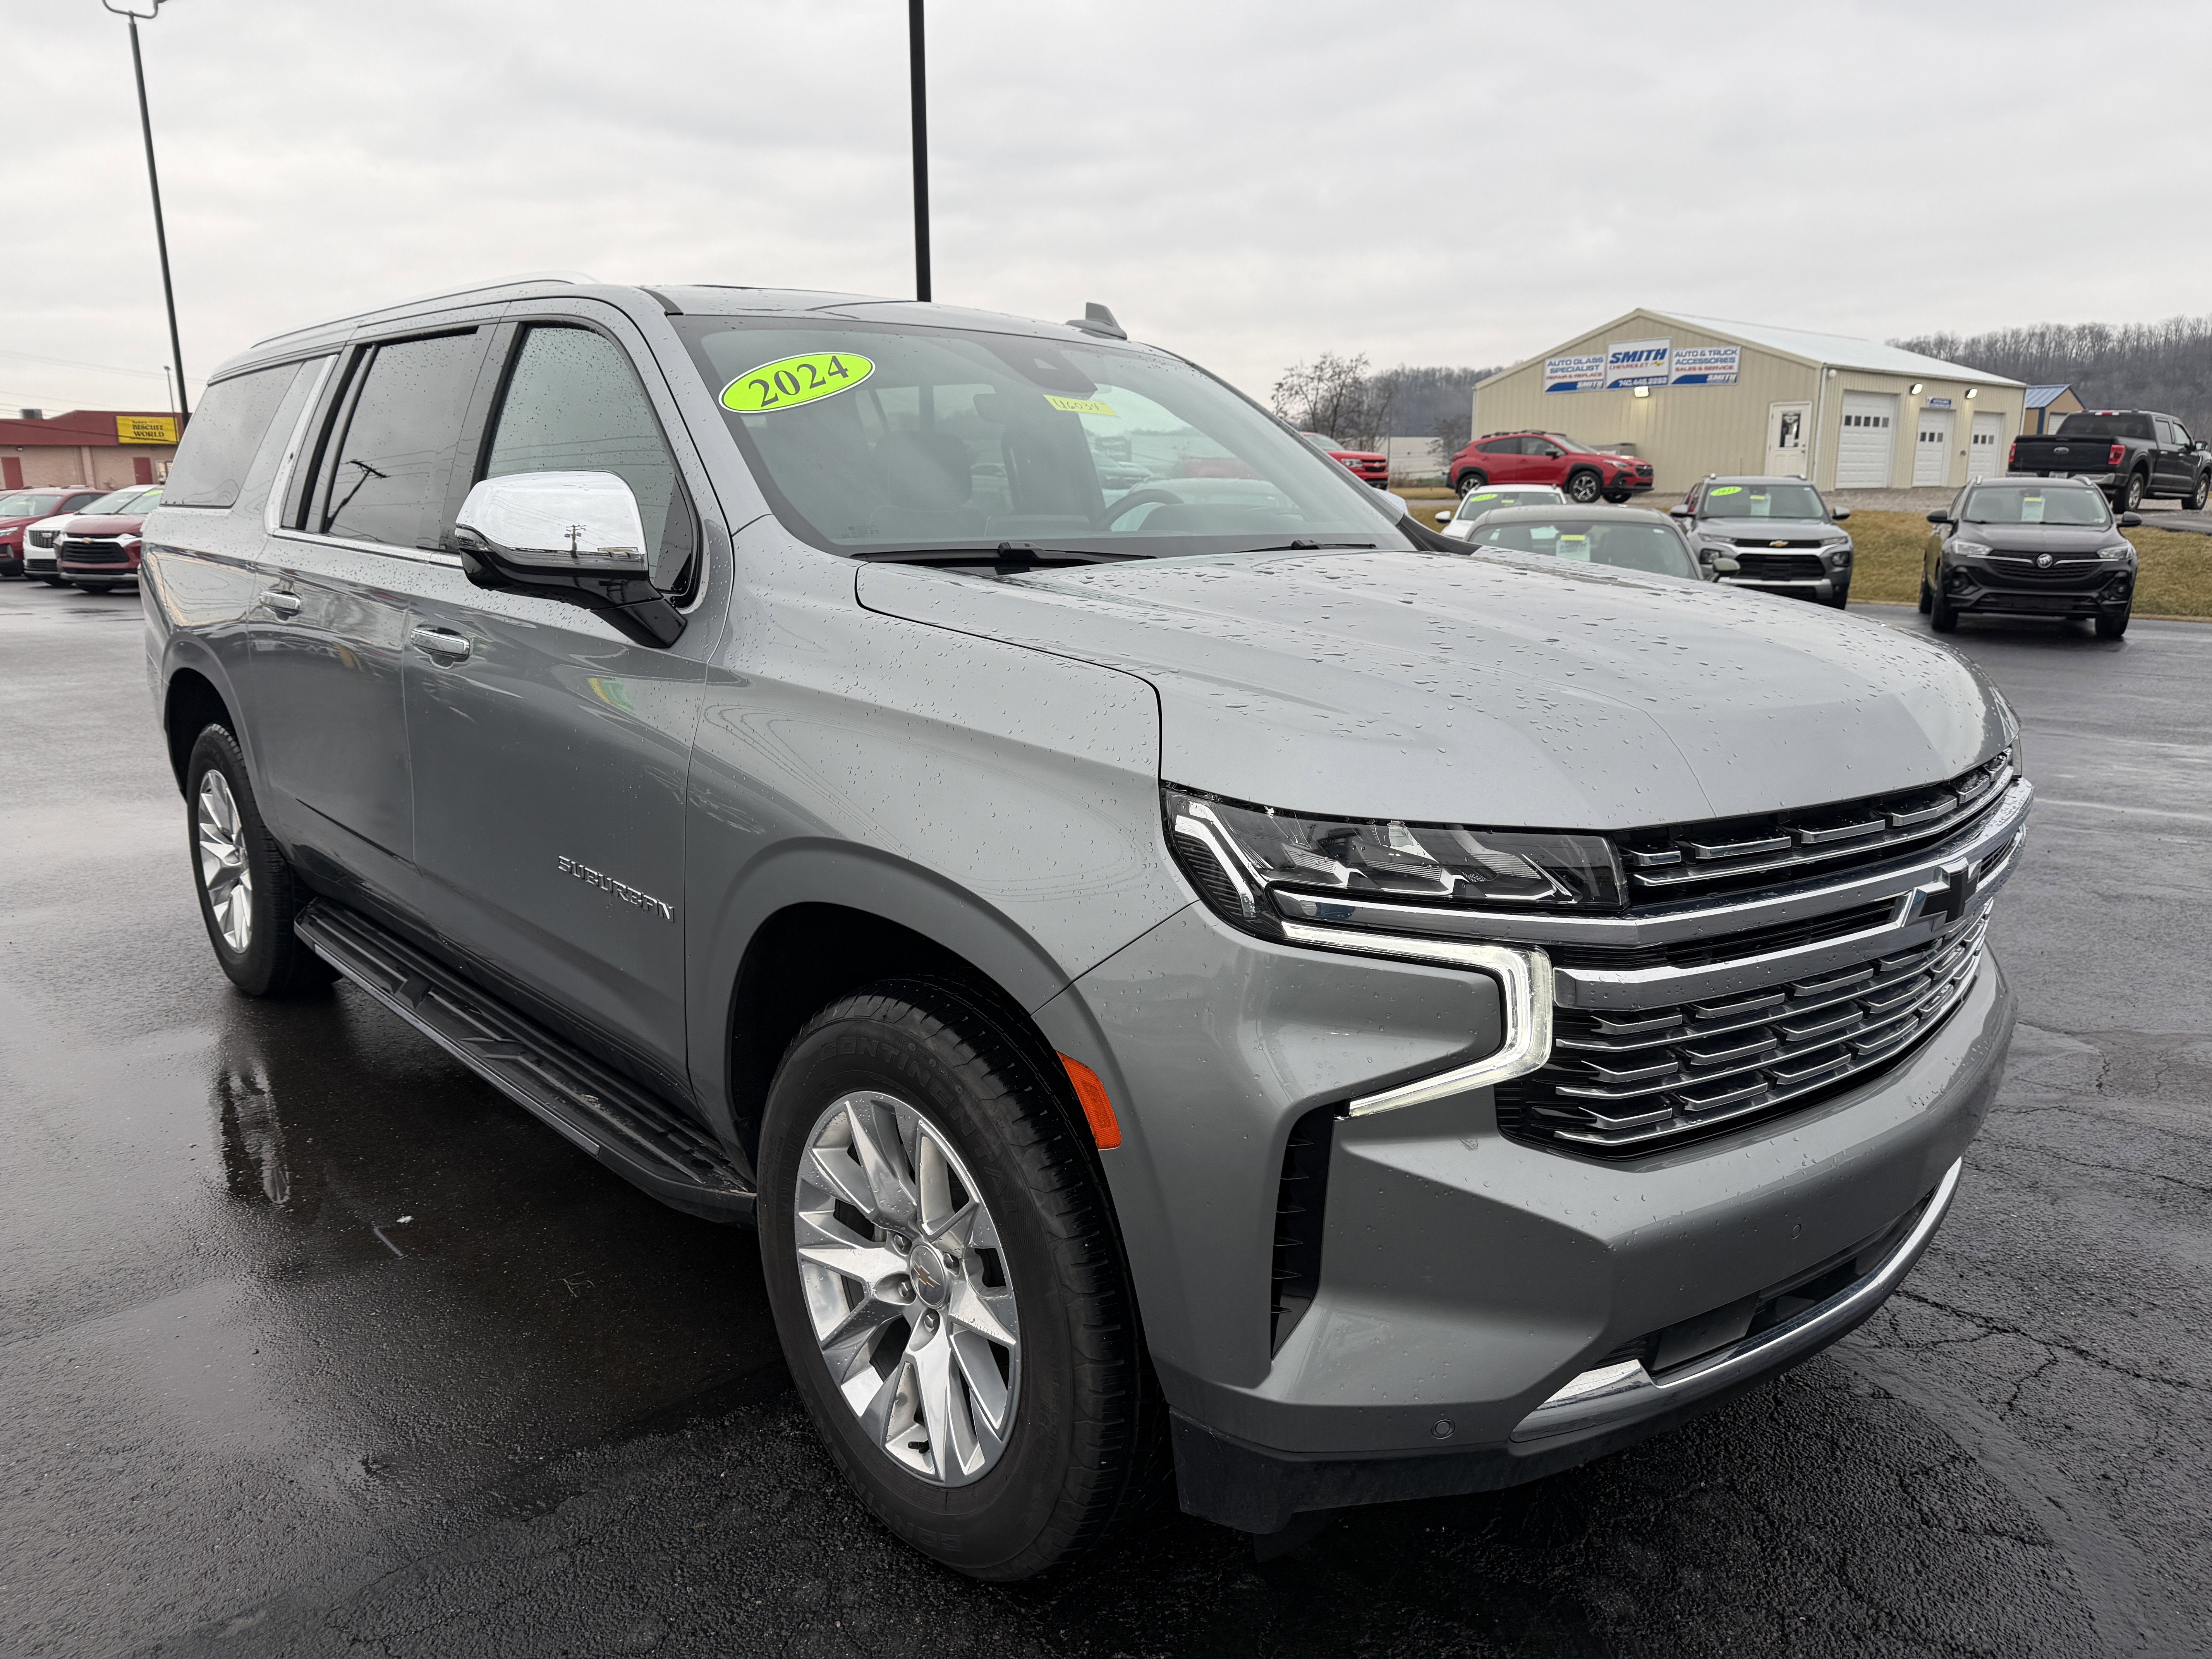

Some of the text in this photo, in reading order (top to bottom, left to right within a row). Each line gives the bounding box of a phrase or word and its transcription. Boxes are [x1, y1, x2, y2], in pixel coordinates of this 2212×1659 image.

[1573, 357, 1603, 365] GLASS
[1609, 348, 1668, 364] SMITH
[1675, 357, 1735, 365] ACCESSORIES
[1550, 364, 1599, 374] SPECIALIST
[748, 355, 849, 407] 2024
[558, 855, 675, 923] SUBURBAN
